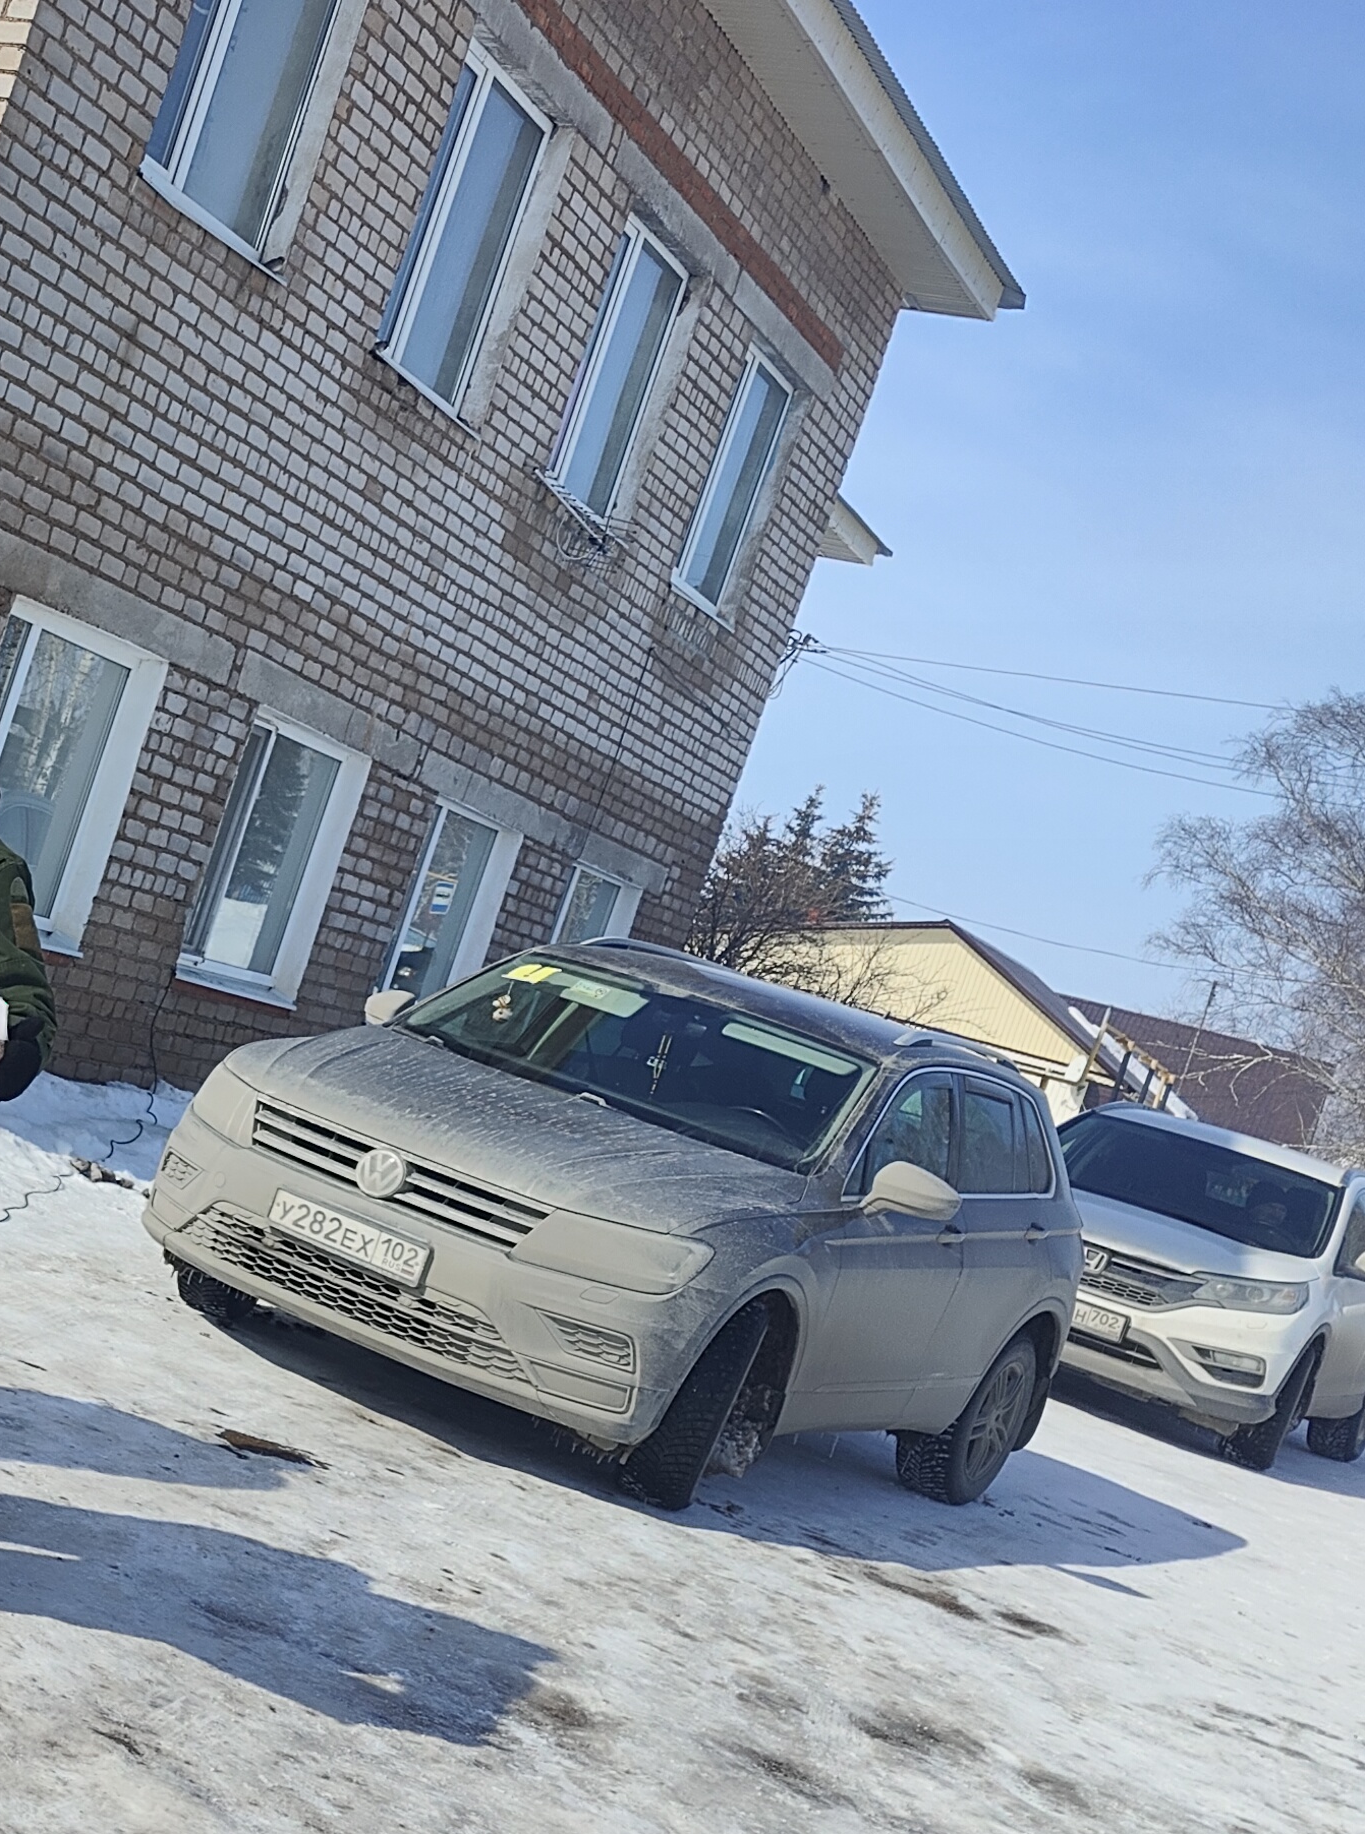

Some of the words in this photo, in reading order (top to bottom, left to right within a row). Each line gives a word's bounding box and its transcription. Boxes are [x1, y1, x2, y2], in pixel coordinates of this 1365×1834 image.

[381, 1238, 419, 1268] 102
[381, 1257, 402, 1272] RUS
[1091, 1309, 1120, 1330] 702
